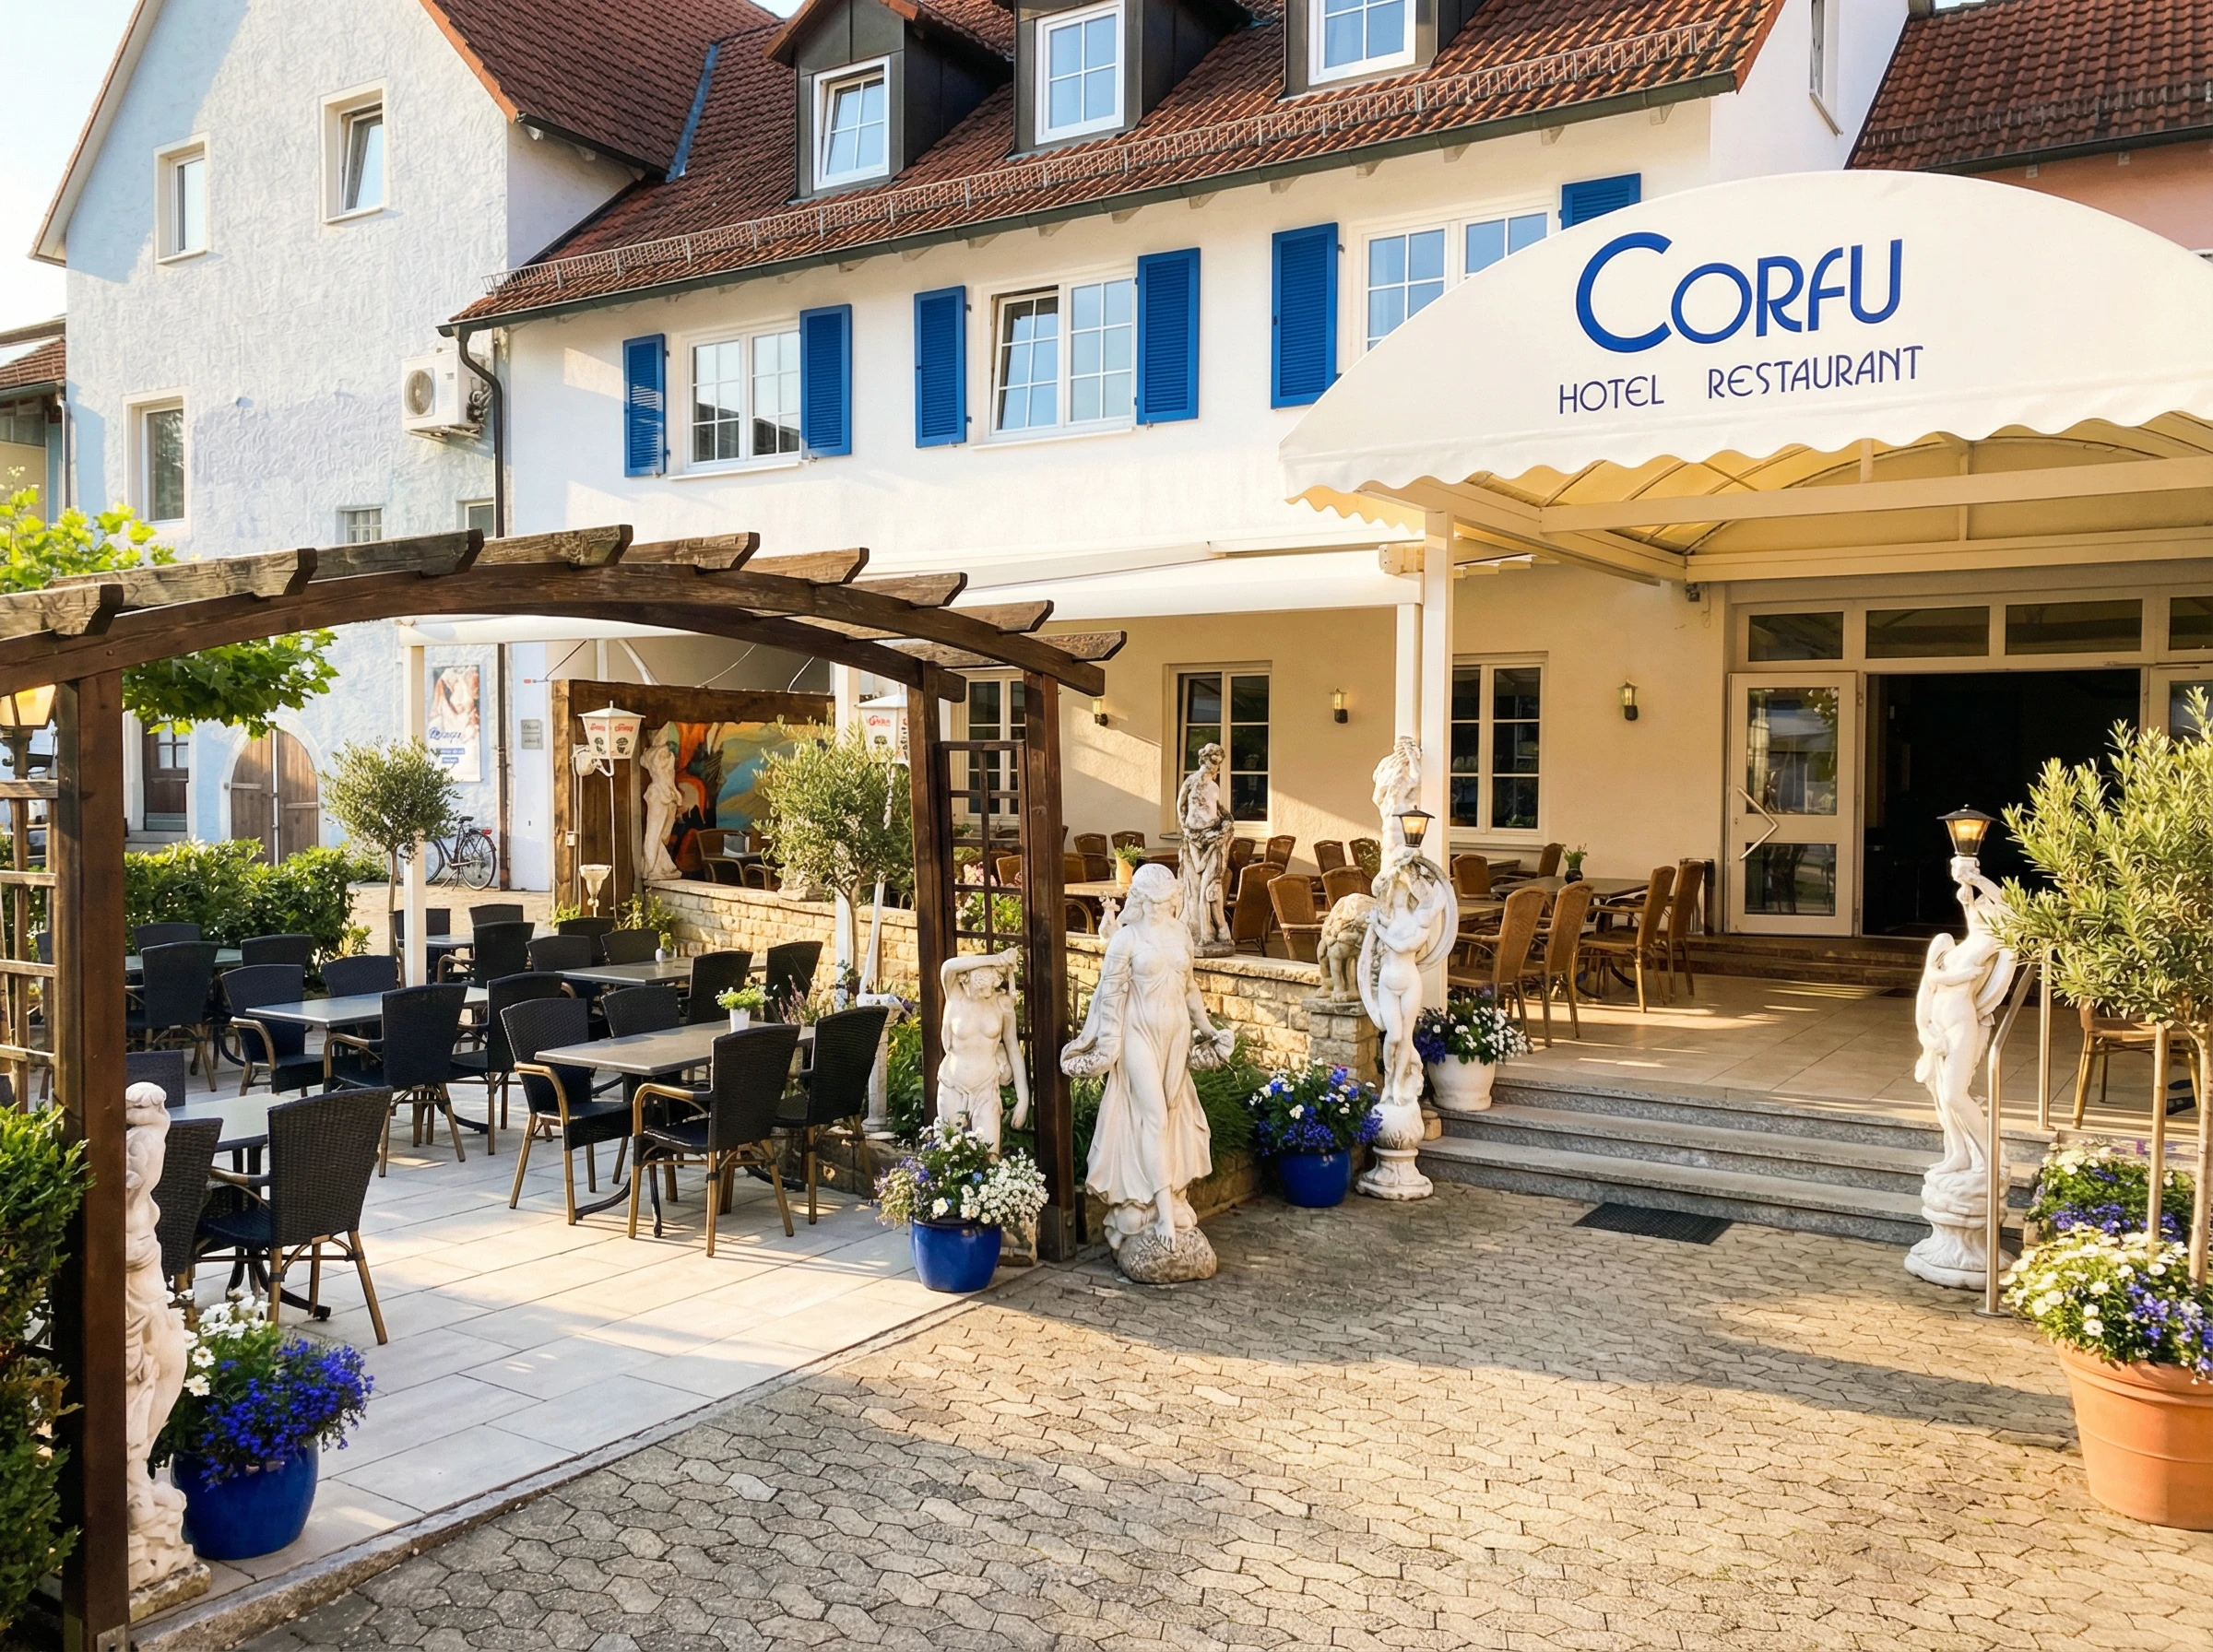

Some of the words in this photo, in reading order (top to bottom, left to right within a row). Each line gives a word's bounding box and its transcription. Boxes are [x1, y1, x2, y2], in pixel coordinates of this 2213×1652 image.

[1576, 231, 1903, 353] CORFU
[1559, 375, 1665, 415] HOTEL
[1708, 345, 1924, 400] RESTAURANT
